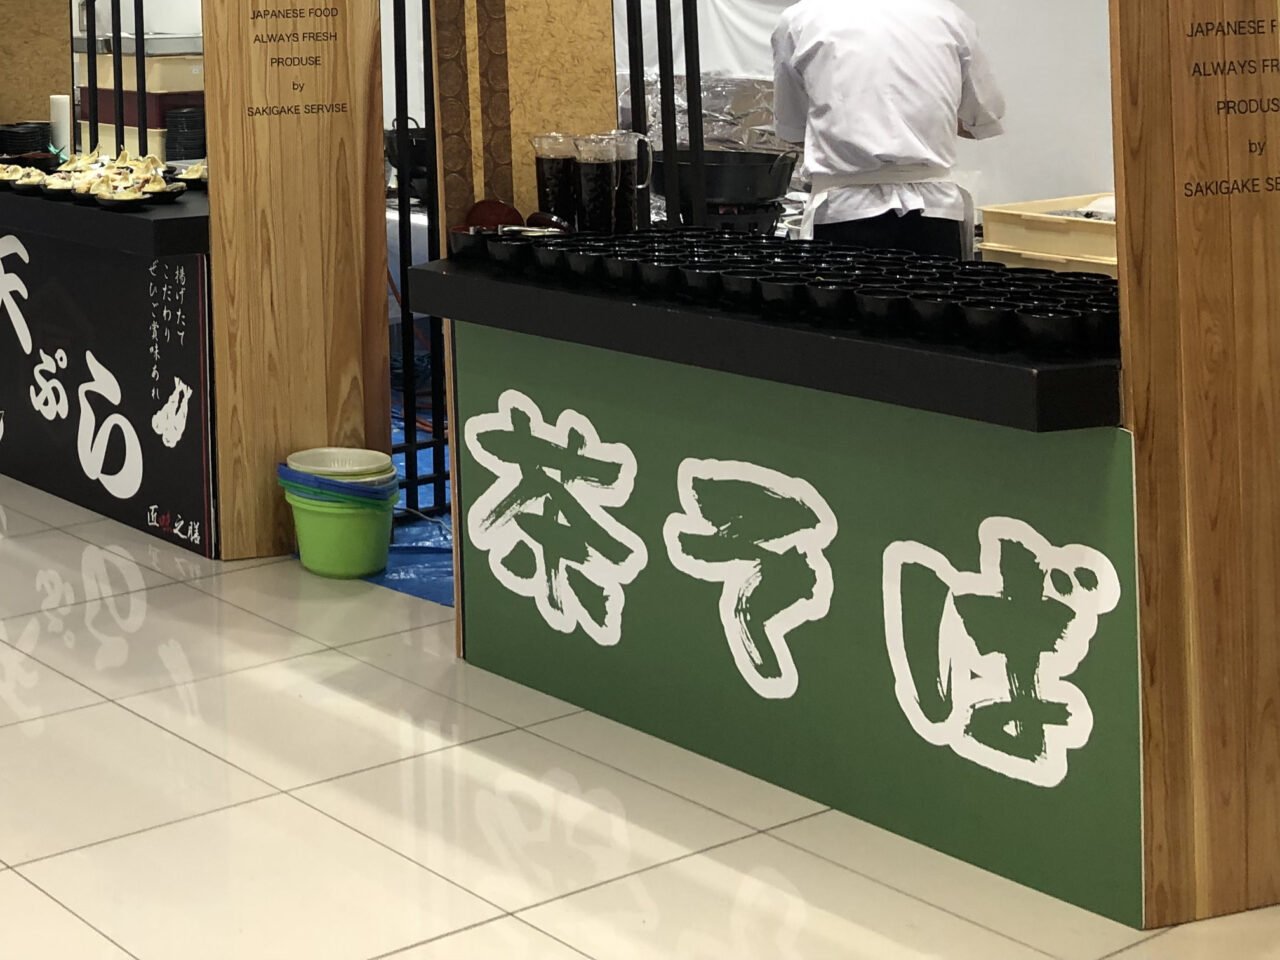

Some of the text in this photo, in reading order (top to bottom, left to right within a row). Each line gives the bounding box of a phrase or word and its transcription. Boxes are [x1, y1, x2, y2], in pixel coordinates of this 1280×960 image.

[250, 7, 339, 20] JAPANESE FOOD
[1186, 19, 1266, 38] JAPANESE
[253, 31, 338, 44] ALWAYS FRESH
[270, 56, 322, 67] PRODUSE
[1191, 59, 1257, 77] ALWAYS
[292, 81, 305, 92] by
[247, 103, 348, 117] SAKIGAKE SERVISE
[1216, 97, 1280, 115] PRODUS
[1248, 139, 1267, 156] by
[1184, 178, 1260, 198] SAKIGAKE
[162, 264, 173, 343] こだわり
[175, 265, 187, 347] 揚げたて
